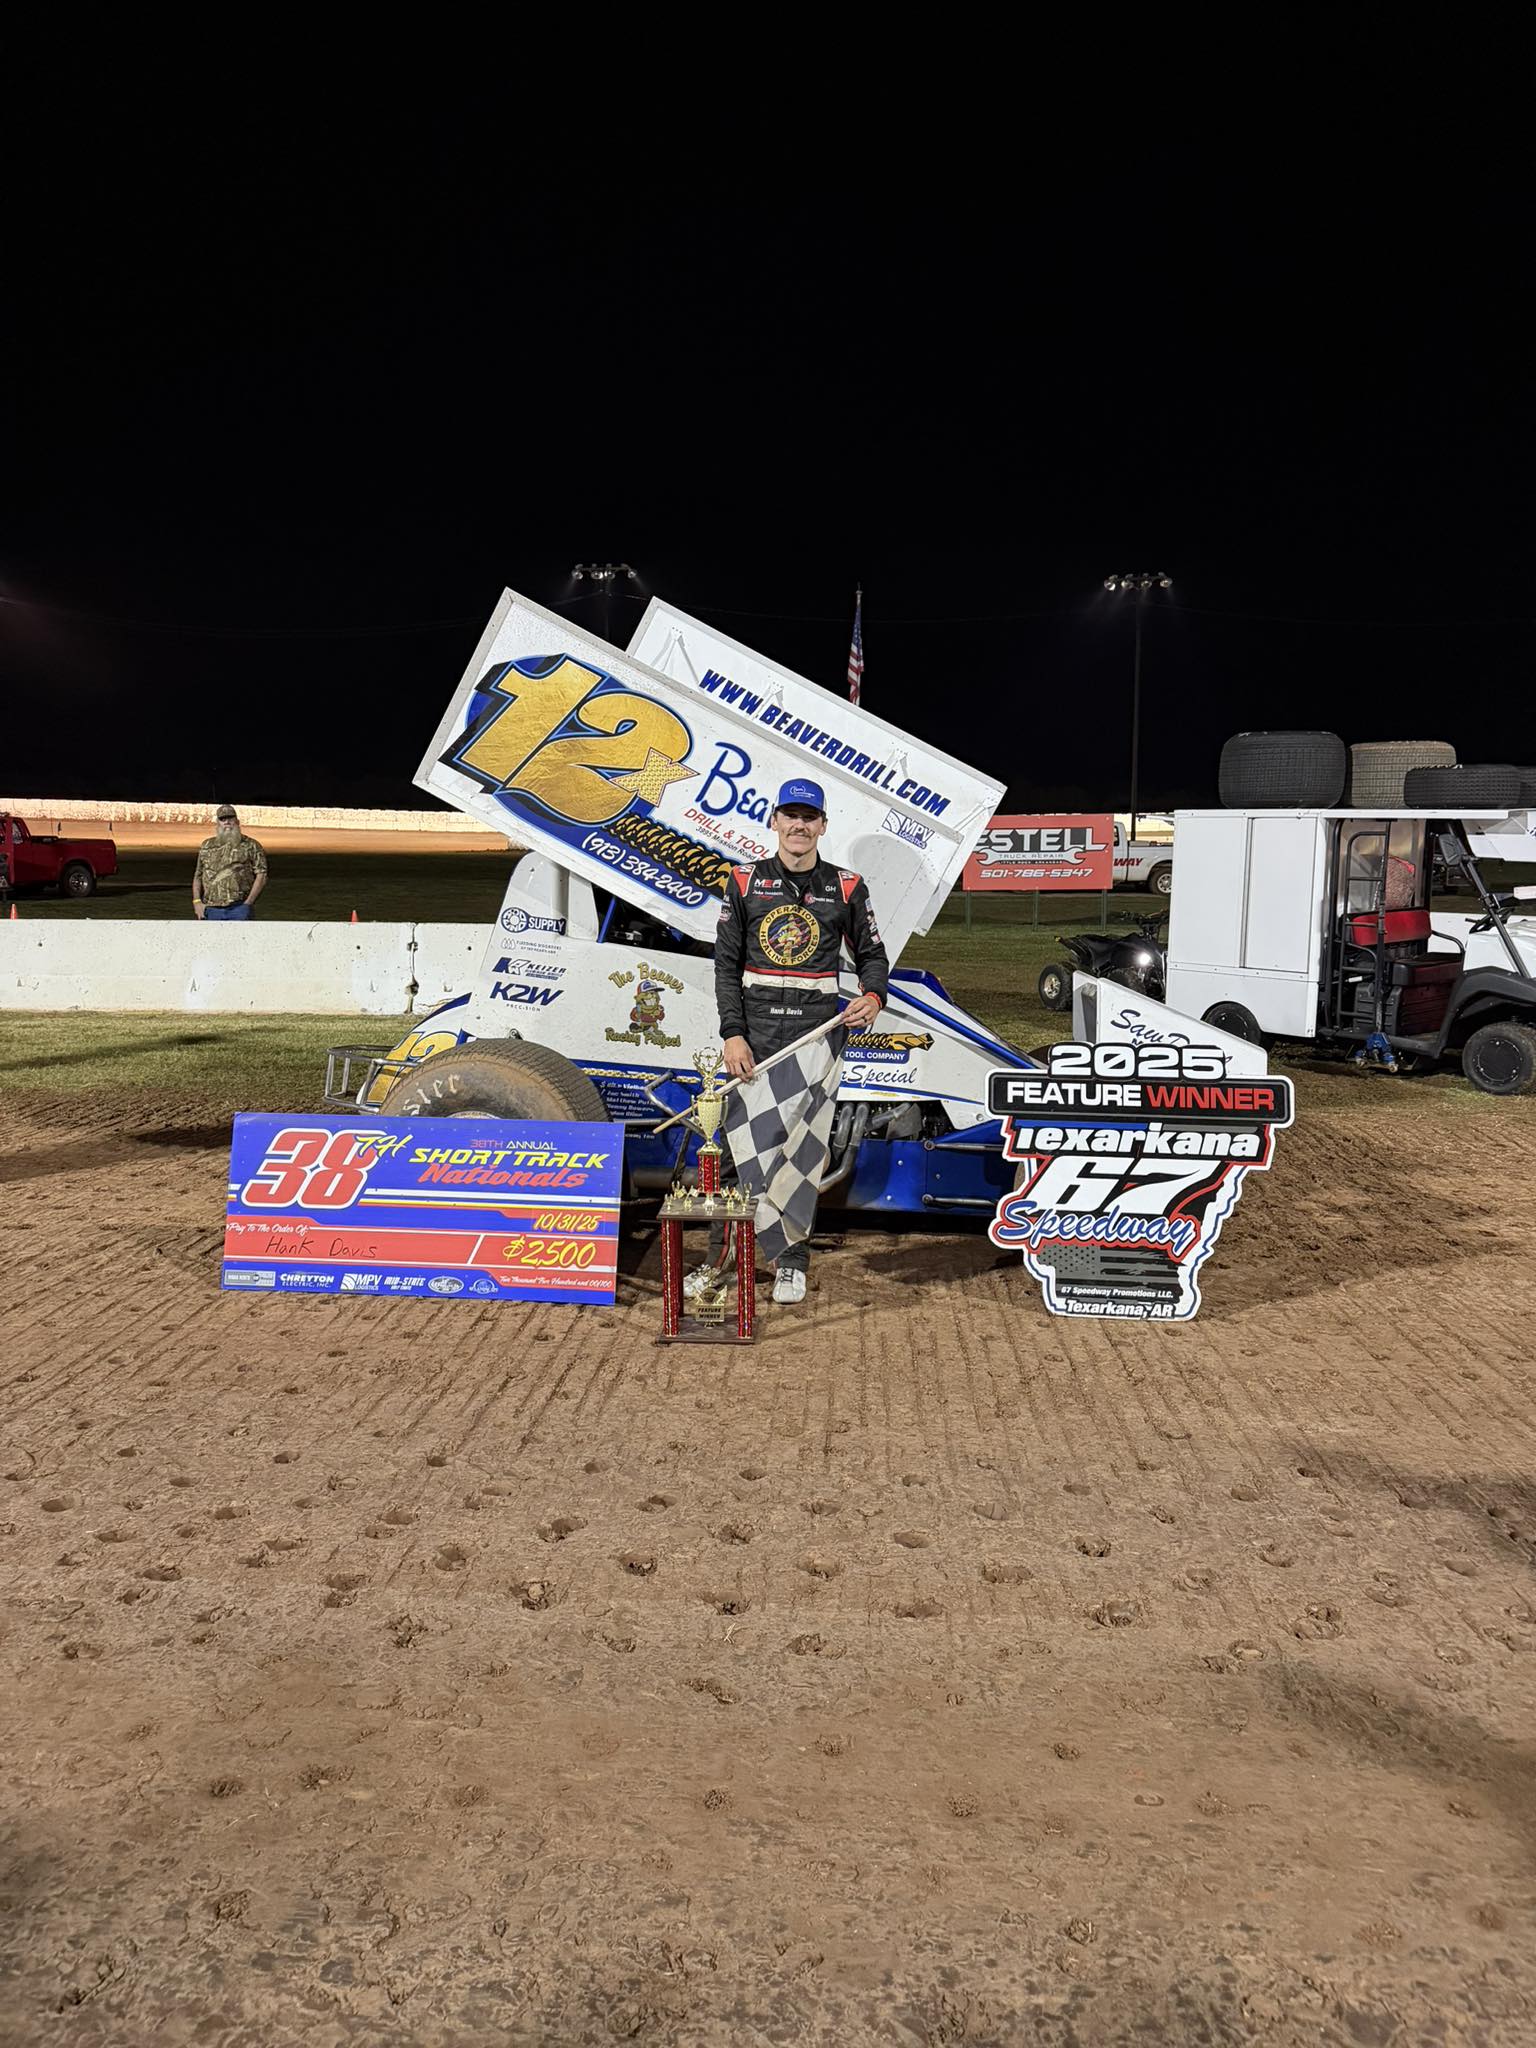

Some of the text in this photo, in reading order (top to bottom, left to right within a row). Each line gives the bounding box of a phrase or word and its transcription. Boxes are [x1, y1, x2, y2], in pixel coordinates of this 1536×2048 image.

[698, 668, 952, 817] WWW.BEAVERDRILL.COM
[683, 807, 771, 859] DRILL & TOOL
[897, 829, 928, 851] LOGISTICS
[901, 817, 936, 844] MPV
[712, 834, 738, 853] Mission
[737, 847, 756, 861] Road
[581, 831, 704, 906] (913) 384-2400
[980, 868, 1094, 879] 501-786-5347
[1113, 858, 1143, 867] WAY
[528, 916, 565, 932] SUPPLY
[765, 904, 817, 926] OPERATION
[760, 930, 788, 964] HEALING
[790, 934, 819, 964] FORCES
[527, 963, 568, 974] KEIZER
[607, 961, 685, 994] The Beaver
[489, 981, 565, 1006] K2W
[770, 1007, 785, 1015] Hank
[604, 1026, 682, 1049] Racing Project
[845, 1051, 906, 1061] TOOL COMPANY
[1050, 1047, 1225, 1079] 2025
[847, 1065, 918, 1087] Special
[1006, 1081, 1275, 1111] FEATURE WINNER
[470, 1140, 558, 1151] 38TH ANNUAL
[1016, 1123, 1260, 1157] Texarkana
[241, 1127, 414, 1209] 38 TH
[409, 1148, 611, 1169] SHORT TRACK
[417, 1163, 590, 1188] Nationals
[1028, 1155, 1222, 1216] 67
[229, 1222, 246, 1235] Pay
[246, 1223, 257, 1232] To
[255, 1224, 271, 1232] The
[271, 1224, 294, 1233] Order
[531, 1212, 602, 1233] 10/31/25
[997, 1199, 1199, 1255] Speedway
[328, 1237, 379, 1259] Davis
[502, 1235, 597, 1268] $2,500
[279, 1273, 335, 1283] CHREYTON
[356, 1273, 383, 1286] MPV
[383, 1276, 427, 1287] MID-STATE
[511, 1275, 538, 1284] Thousand
[550, 1277, 577, 1286] Hundred
[576, 1279, 589, 1287] and
[1072, 1287, 1111, 1297] Speedway
[1112, 1289, 1156, 1297] Promotions
[1066, 1300, 1174, 1318] Texarkana, AR
